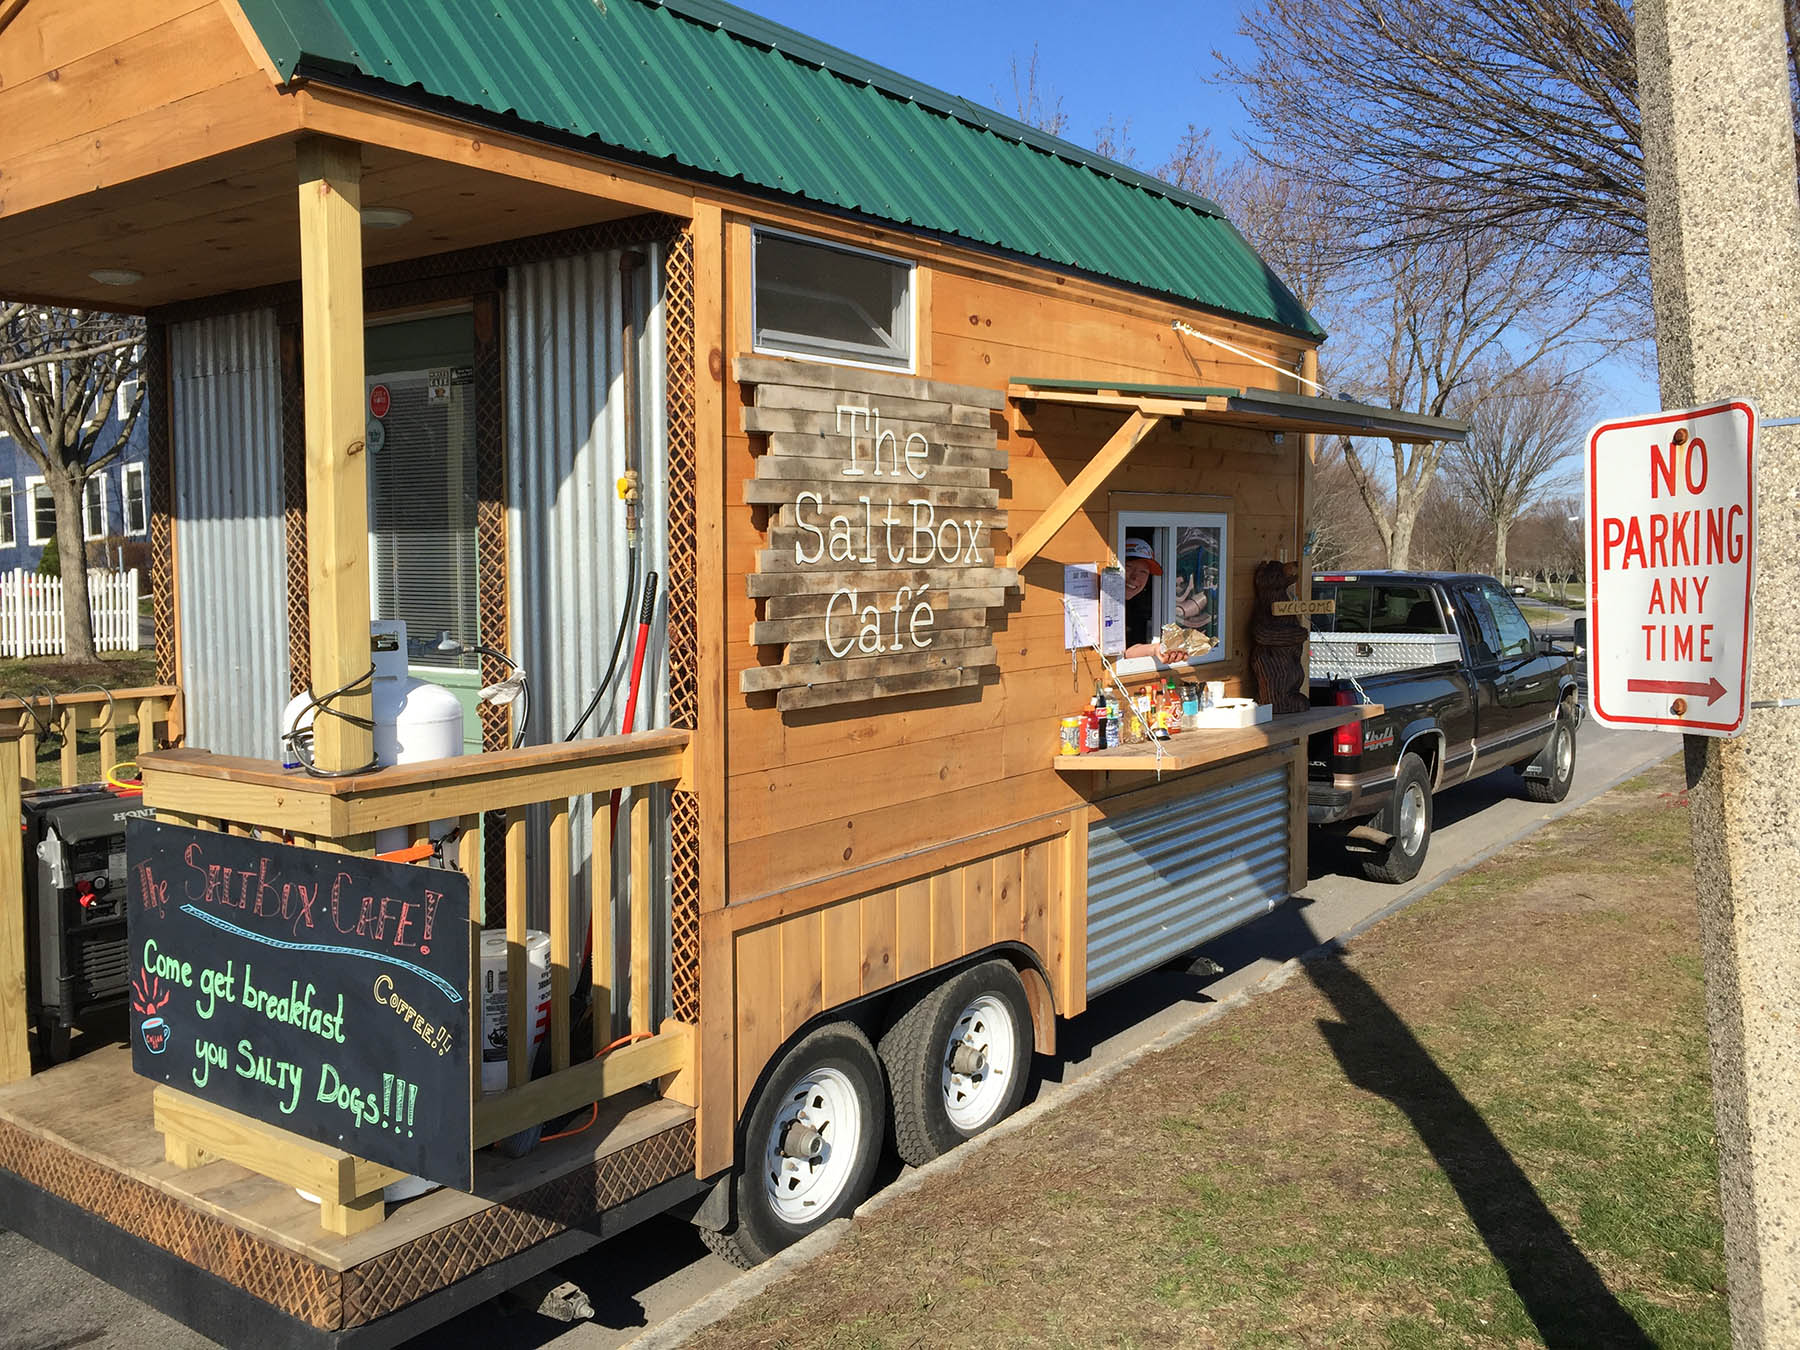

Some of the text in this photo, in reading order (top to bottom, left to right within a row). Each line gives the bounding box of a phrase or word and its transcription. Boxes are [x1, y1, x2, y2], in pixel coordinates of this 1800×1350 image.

[836, 405, 928, 479] The
[1650, 437, 1709, 499] NO
[795, 491, 984, 565] SaltBox
[1603, 504, 1744, 570] PARKING
[825, 583, 935, 658] Café
[1278, 600, 1333, 613] WELCOME
[1648, 576, 1709, 615] ANY
[1641, 624, 1714, 662] TIME
[131, 857, 170, 919] The
[331, 872, 444, 956] CAFE!
[143, 938, 346, 1044] Come get breakfast
[192, 1039, 228, 1088] you
